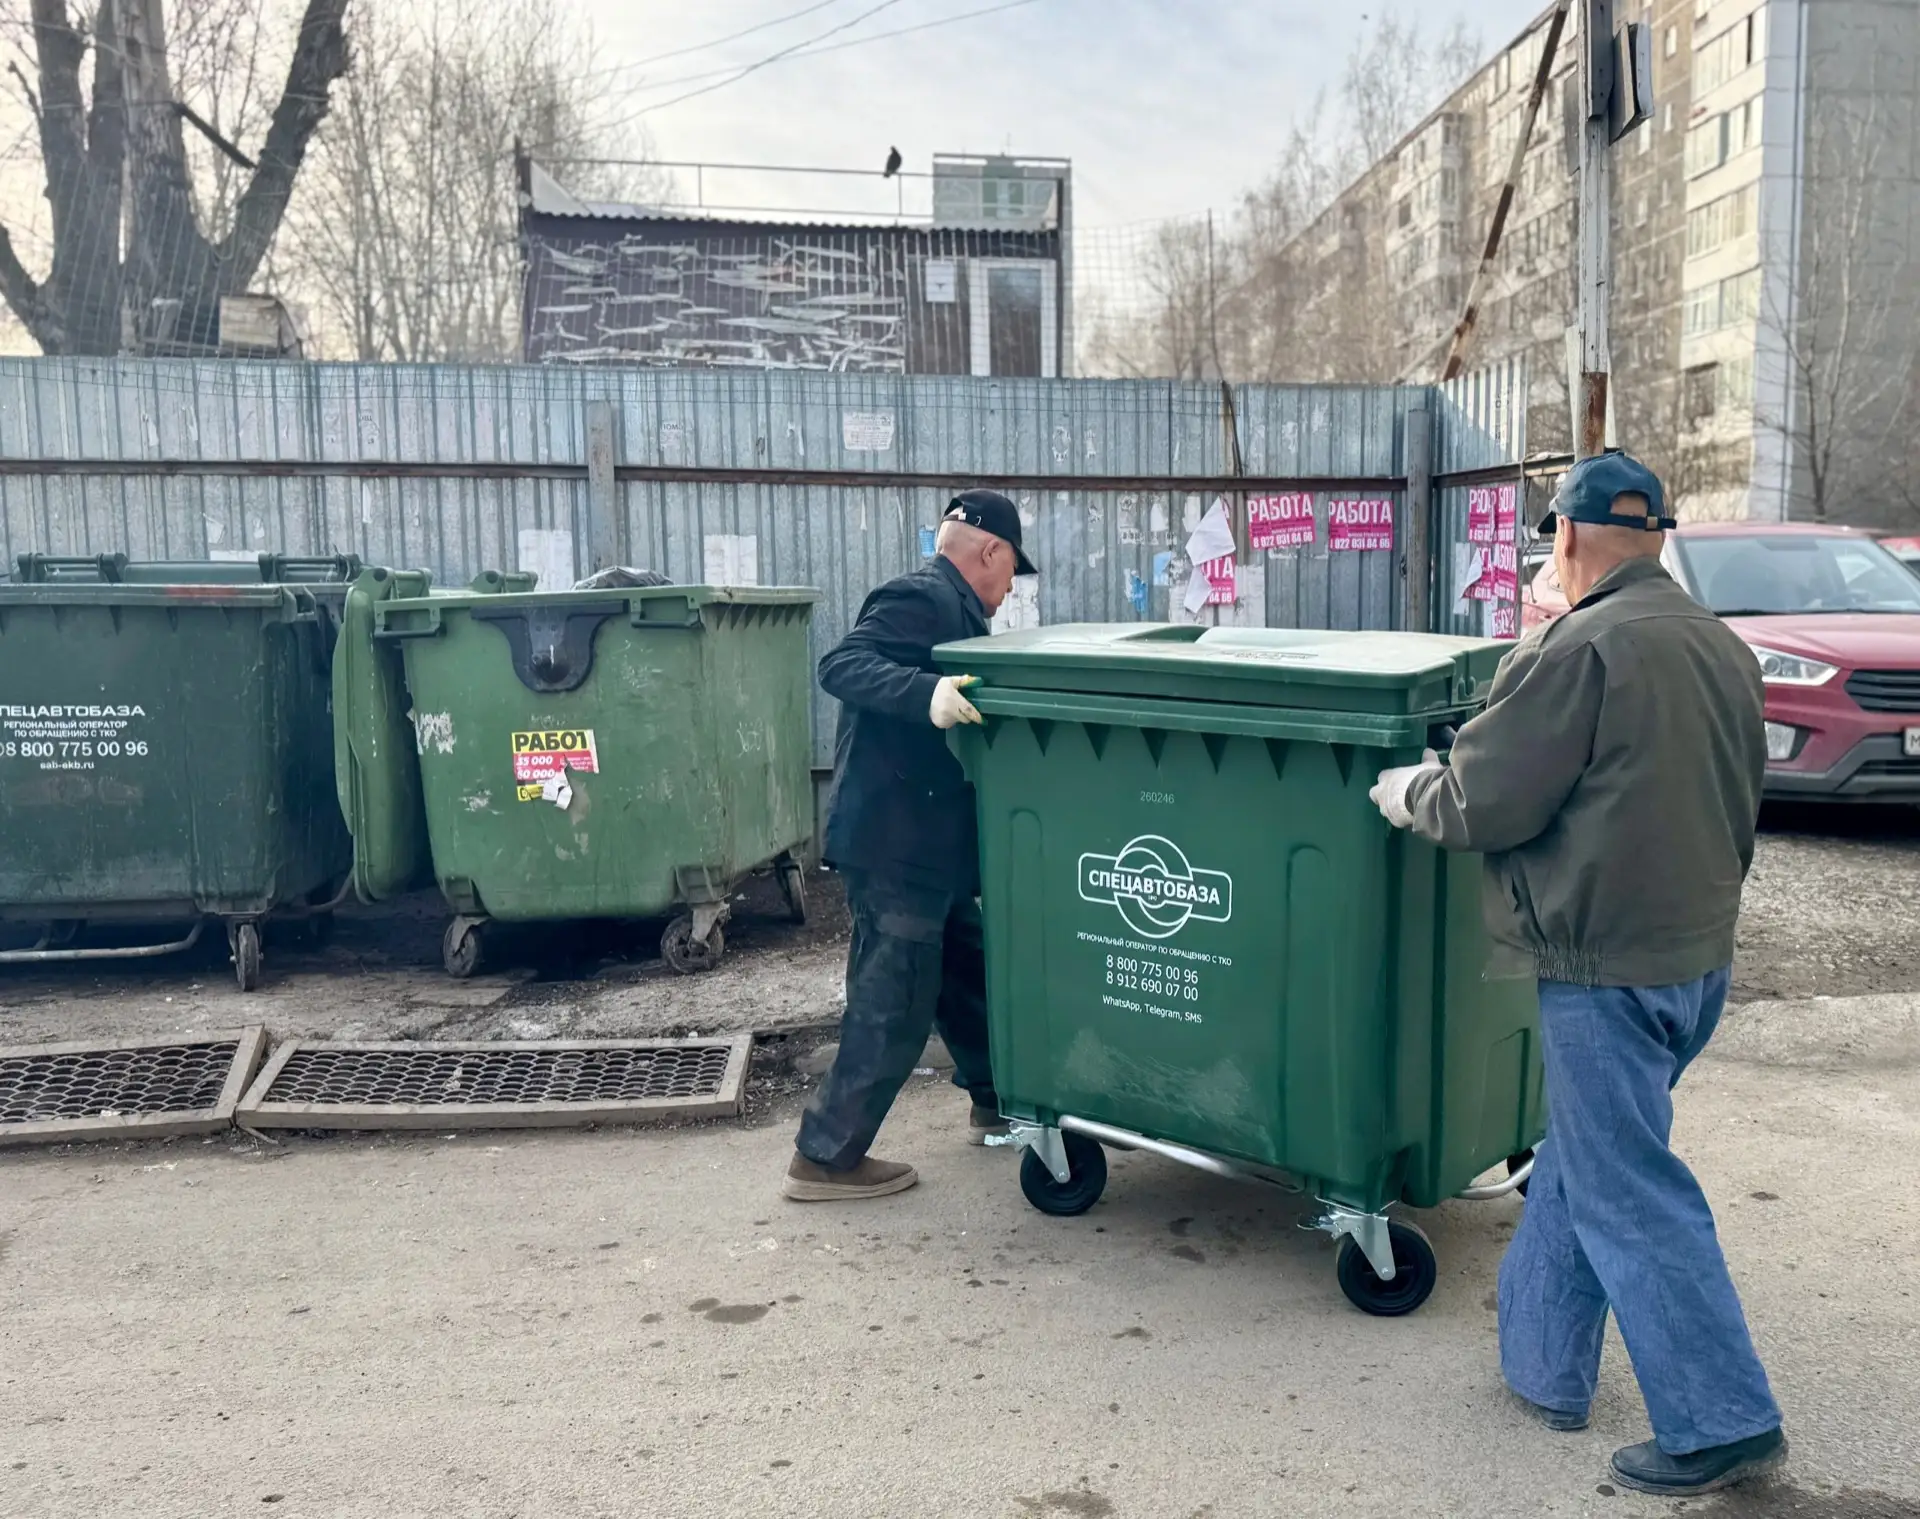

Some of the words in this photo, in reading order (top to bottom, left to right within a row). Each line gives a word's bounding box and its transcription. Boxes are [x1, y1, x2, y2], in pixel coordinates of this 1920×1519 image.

[1248, 493, 1314, 523] РАБОТА
[1328, 500, 1393, 525] РАБОТА
[4, 720, 77, 729] РЕГИОНАЛЬНЫЙ
[79, 721, 127, 729] ОПЕРАТОР
[14, 730, 27, 738] ПО
[29, 730, 89, 739] ОБРАЩЕНИЮ
[90, 730, 97, 738] С
[100, 730, 117, 738] ТКО
[21, 741, 54, 757] 800
[59, 741, 92, 757] 775
[97, 741, 120, 757] 00
[125, 741, 148, 757] 96
[531, 755, 553, 765] 000
[532, 769, 556, 779] 000
[1140, 791, 1175, 804] 260246
[1088, 870, 1221, 905] СПЕЦАВТОБАЗА
[1077, 931, 1124, 947] РЕГИОНАЛЬНЫЙ
[1125, 940, 1157, 952] ОПЕРАТОР
[1158, 946, 1168, 954] ПО
[1168, 948, 1211, 962] ОБРАЩЕНИЮ
[1211, 955, 1217, 963] С
[1218, 956, 1232, 966] ТКО
[1106, 954, 1114, 968] 8
[1116, 956, 1138, 972] 800
[1141, 961, 1162, 977] 775
[1165, 965, 1180, 981] 00
[1183, 969, 1199, 984] 96
[1106, 971, 1114, 985] 8
[1116, 973, 1138, 989] 912
[1141, 977, 1162, 994] 690
[1165, 982, 1180, 997] 07
[1183, 986, 1199, 1001] 00
[1102, 994, 1142, 1013] WhatsApp,
[1144, 1003, 1183, 1021] Telegram,
[1184, 1012, 1202, 1024] SMS
